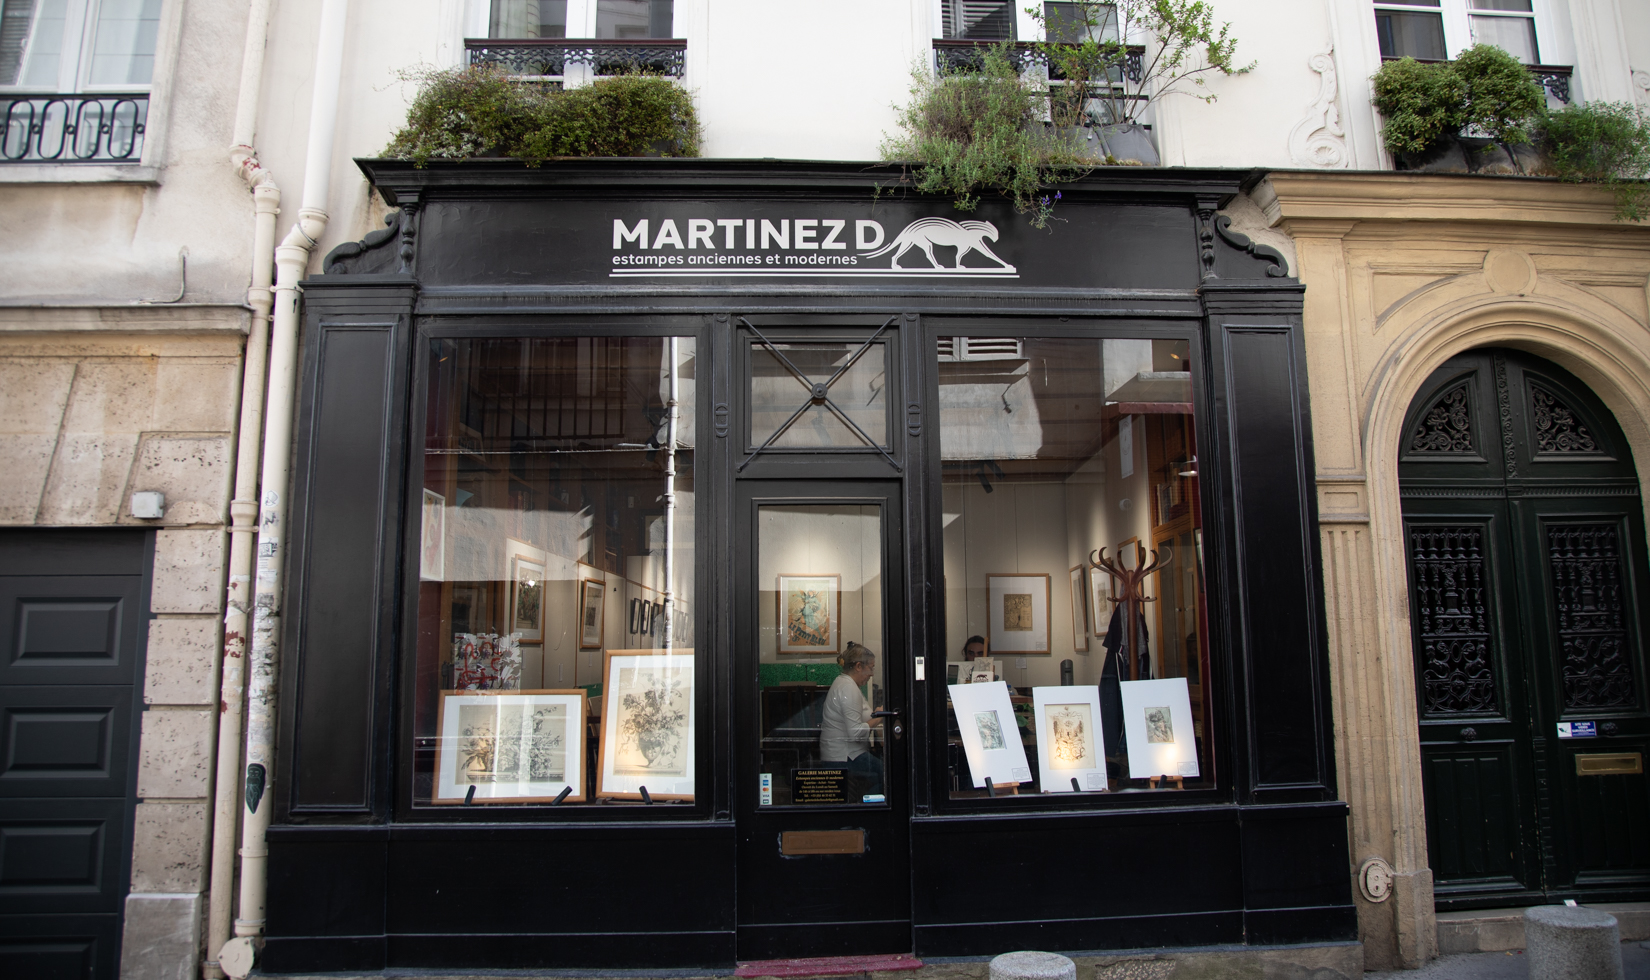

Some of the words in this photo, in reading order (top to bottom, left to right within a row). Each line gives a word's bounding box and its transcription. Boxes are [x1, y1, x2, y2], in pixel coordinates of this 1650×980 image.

[612, 219, 847, 250] MARTINEZ
[855, 219, 885, 250] D
[612, 253, 684, 268] estampes
[687, 253, 762, 265] anciennes
[765, 253, 781, 265] et
[785, 253, 858, 265] modernes
